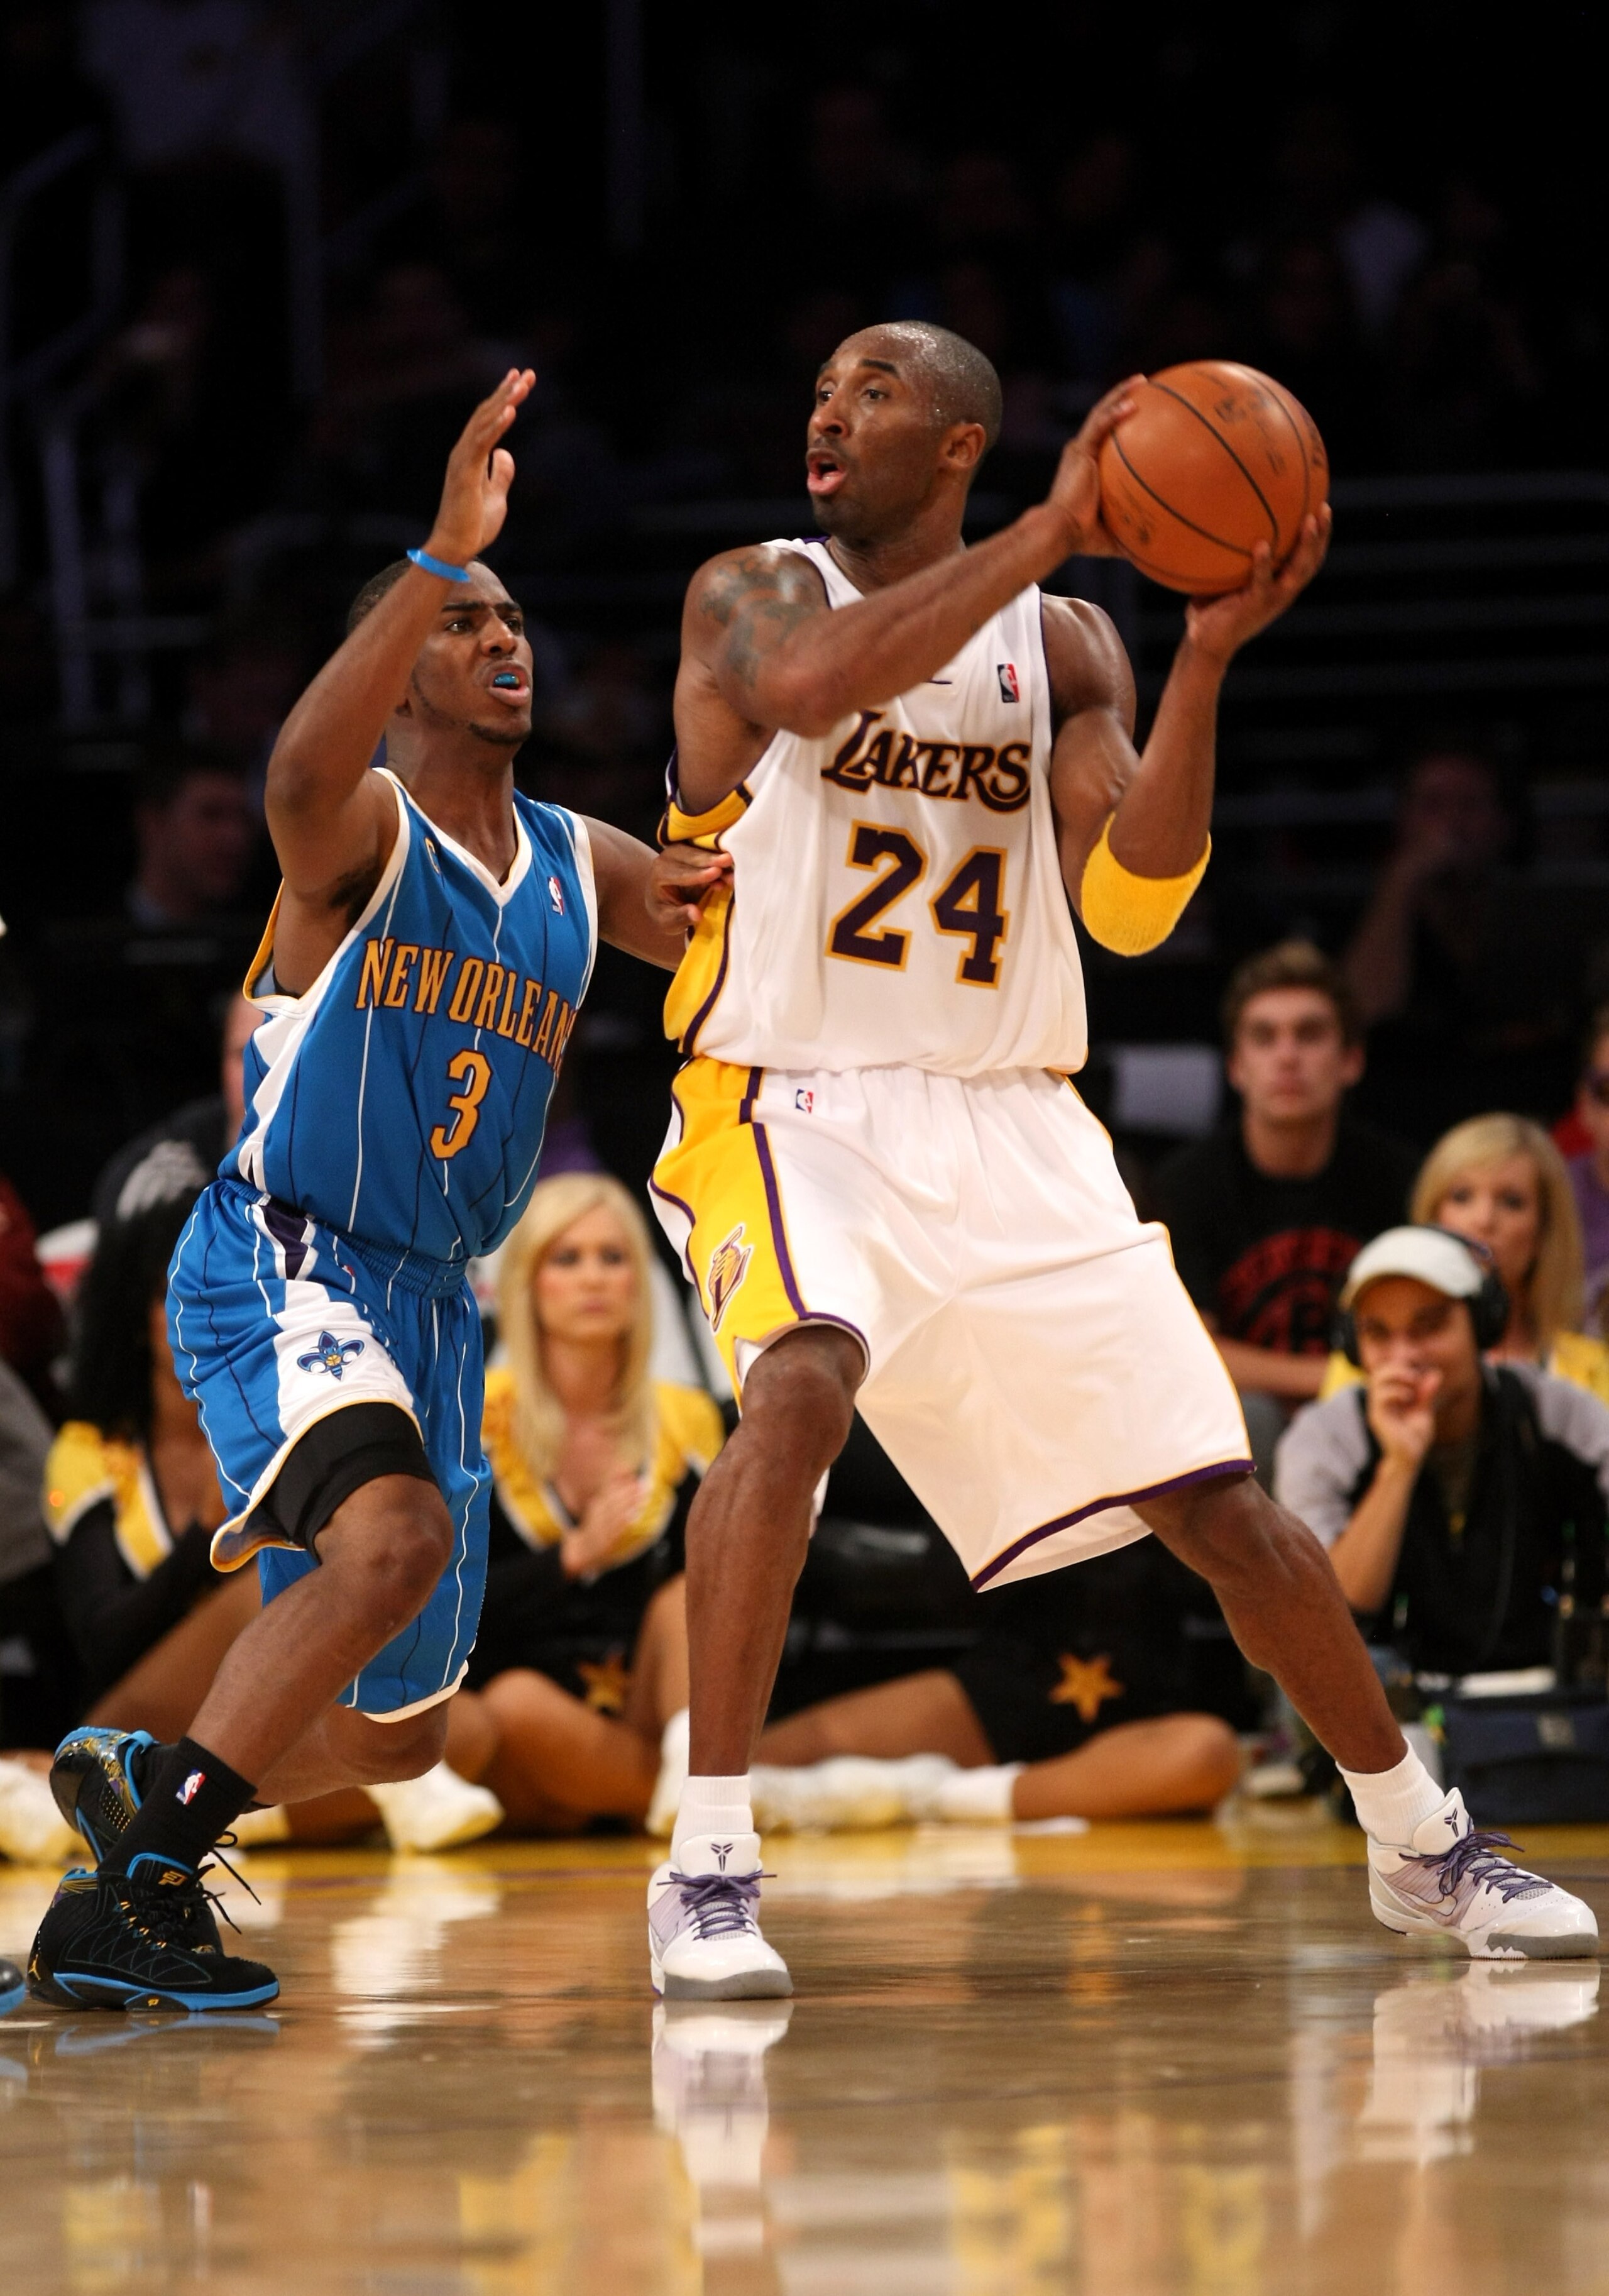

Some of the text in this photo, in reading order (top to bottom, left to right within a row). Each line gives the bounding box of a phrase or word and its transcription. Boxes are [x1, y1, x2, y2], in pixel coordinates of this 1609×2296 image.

[820, 709, 1031, 814] LAKERS
[825, 820, 1010, 990] 24
[356, 936, 577, 1081] NEW ORLEAN
[430, 1048, 492, 1159] 3
